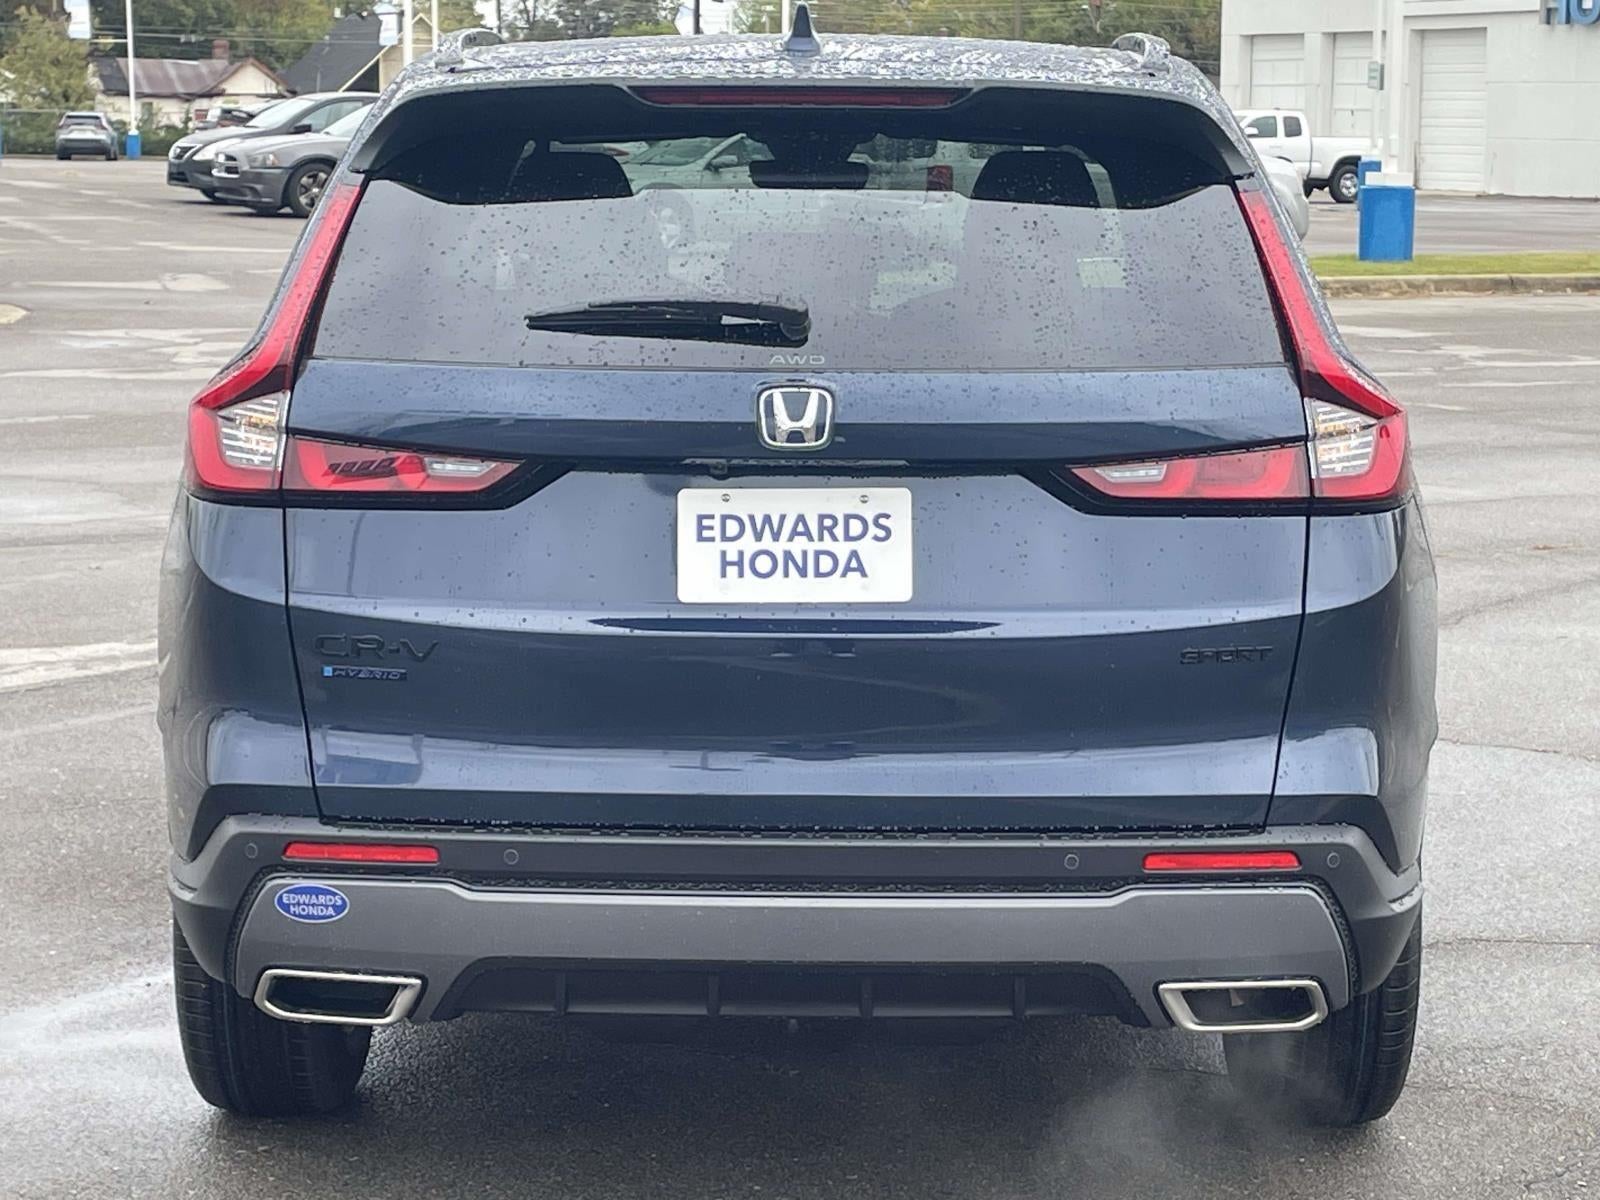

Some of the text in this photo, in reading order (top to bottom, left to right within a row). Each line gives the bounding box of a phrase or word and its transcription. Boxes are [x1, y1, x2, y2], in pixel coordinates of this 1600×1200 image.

[769, 354, 826, 365] AWD
[695, 512, 893, 543] EDWARDS
[719, 548, 869, 580] HONDA
[313, 632, 440, 662] CR-V
[1180, 645, 1273, 665] SPORT
[333, 668, 402, 680] HYBRID
[282, 893, 343, 906] EDWARDS
[289, 904, 336, 916] HONDA
